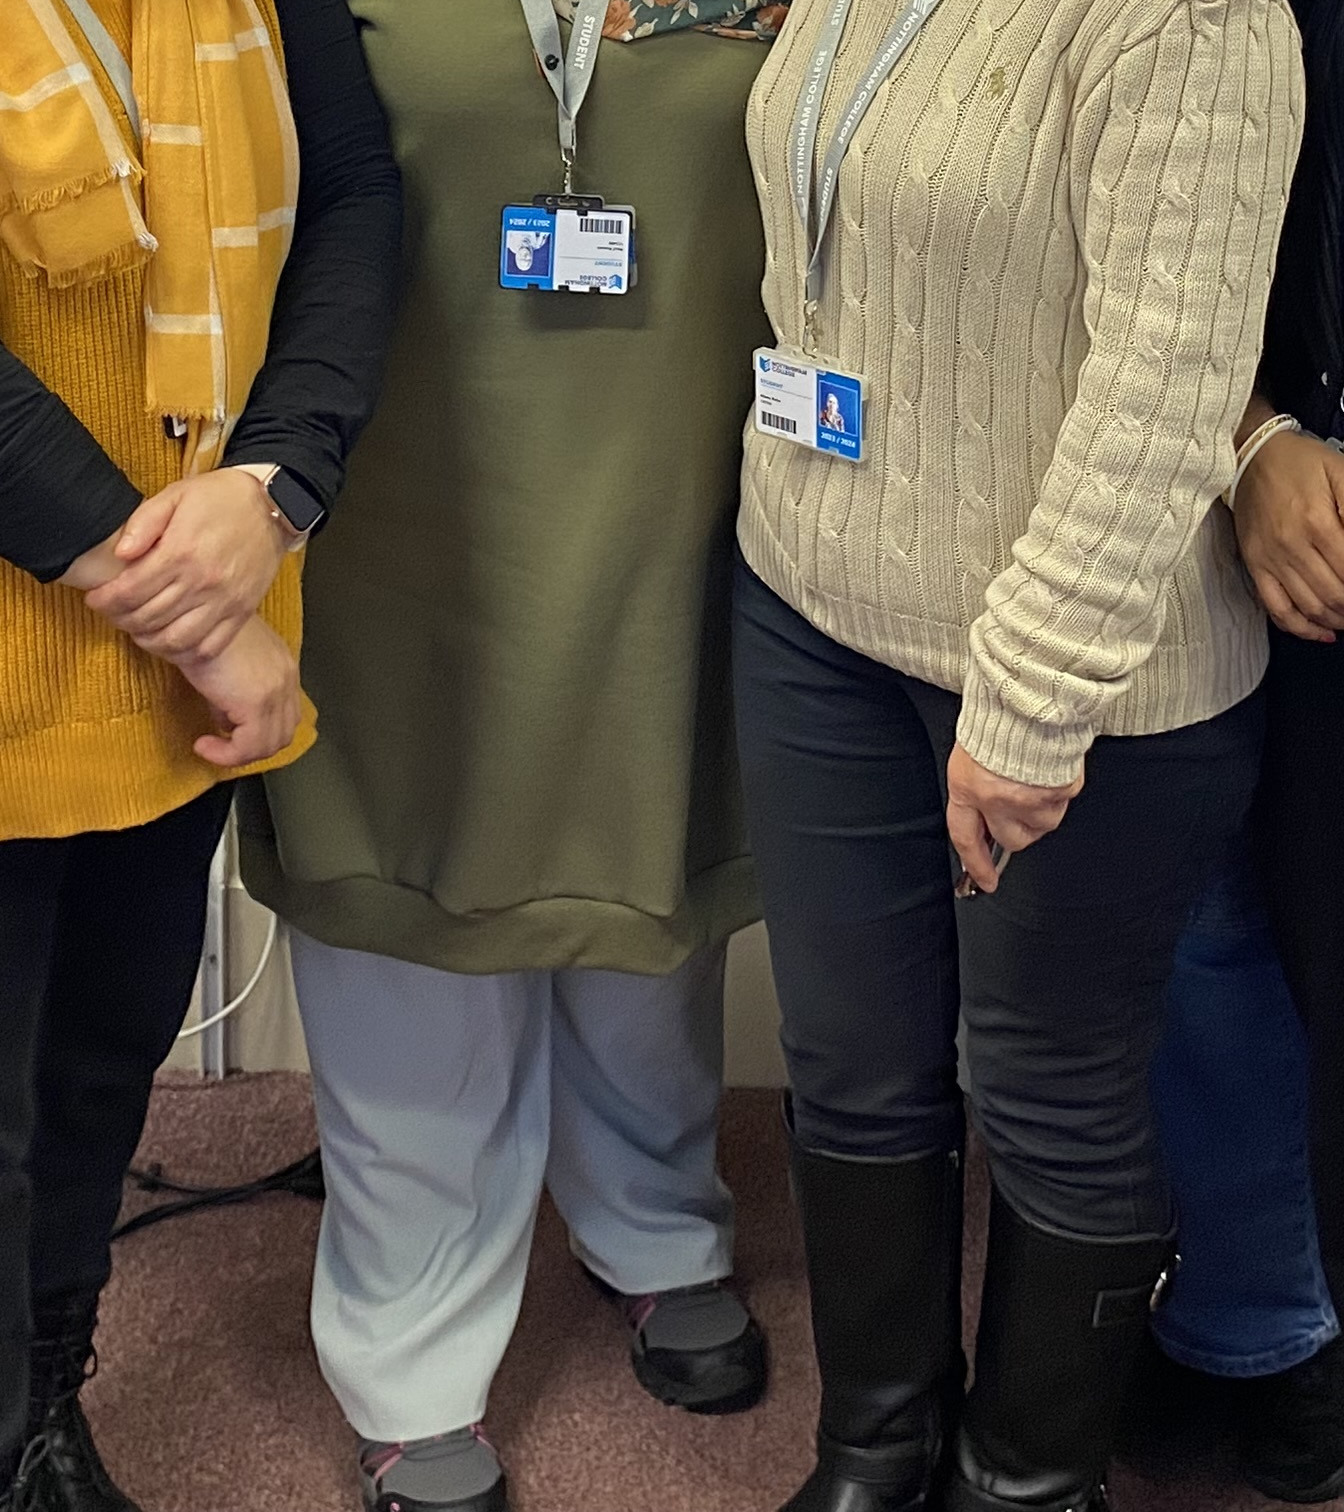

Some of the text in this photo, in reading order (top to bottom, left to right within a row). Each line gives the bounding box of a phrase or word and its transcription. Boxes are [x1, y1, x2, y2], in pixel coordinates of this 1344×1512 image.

[573, 15, 596, 70] STUDENT
[868, 12, 919, 91] NOTTINGHAM
[796, 49, 828, 194] NOTTINGHAM COLLEGE
[837, 90, 868, 144] COLLEGE
